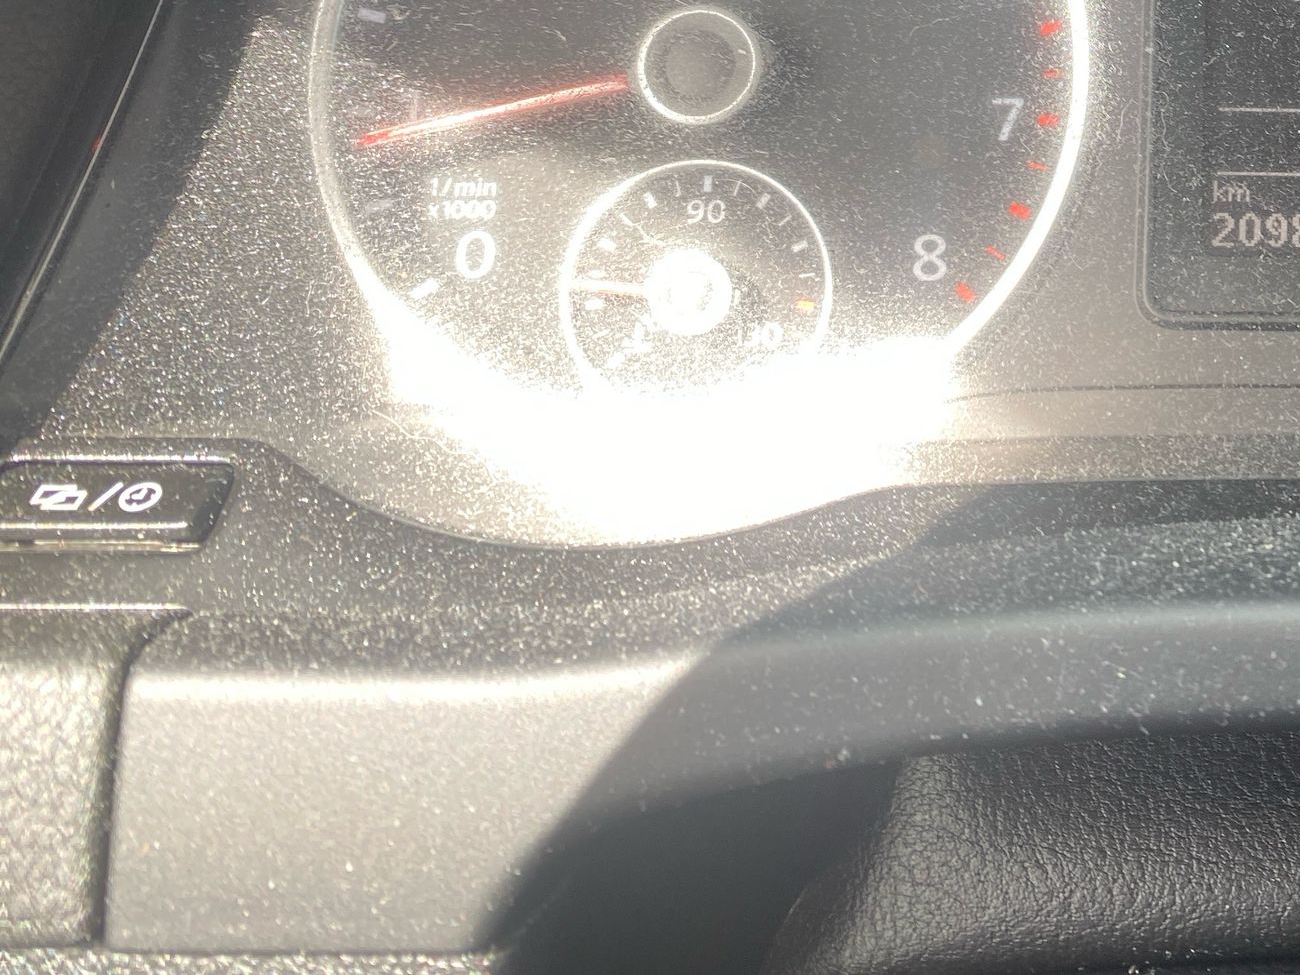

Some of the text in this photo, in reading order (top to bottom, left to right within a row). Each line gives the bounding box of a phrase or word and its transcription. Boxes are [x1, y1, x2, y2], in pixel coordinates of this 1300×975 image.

[992, 98, 1024, 141] 7
[430, 176, 498, 197] 1/min
[1212, 181, 1250, 204] km
[686, 199, 726, 224] 90
[455, 230, 496, 279] 0
[912, 234, 947, 280] 8
